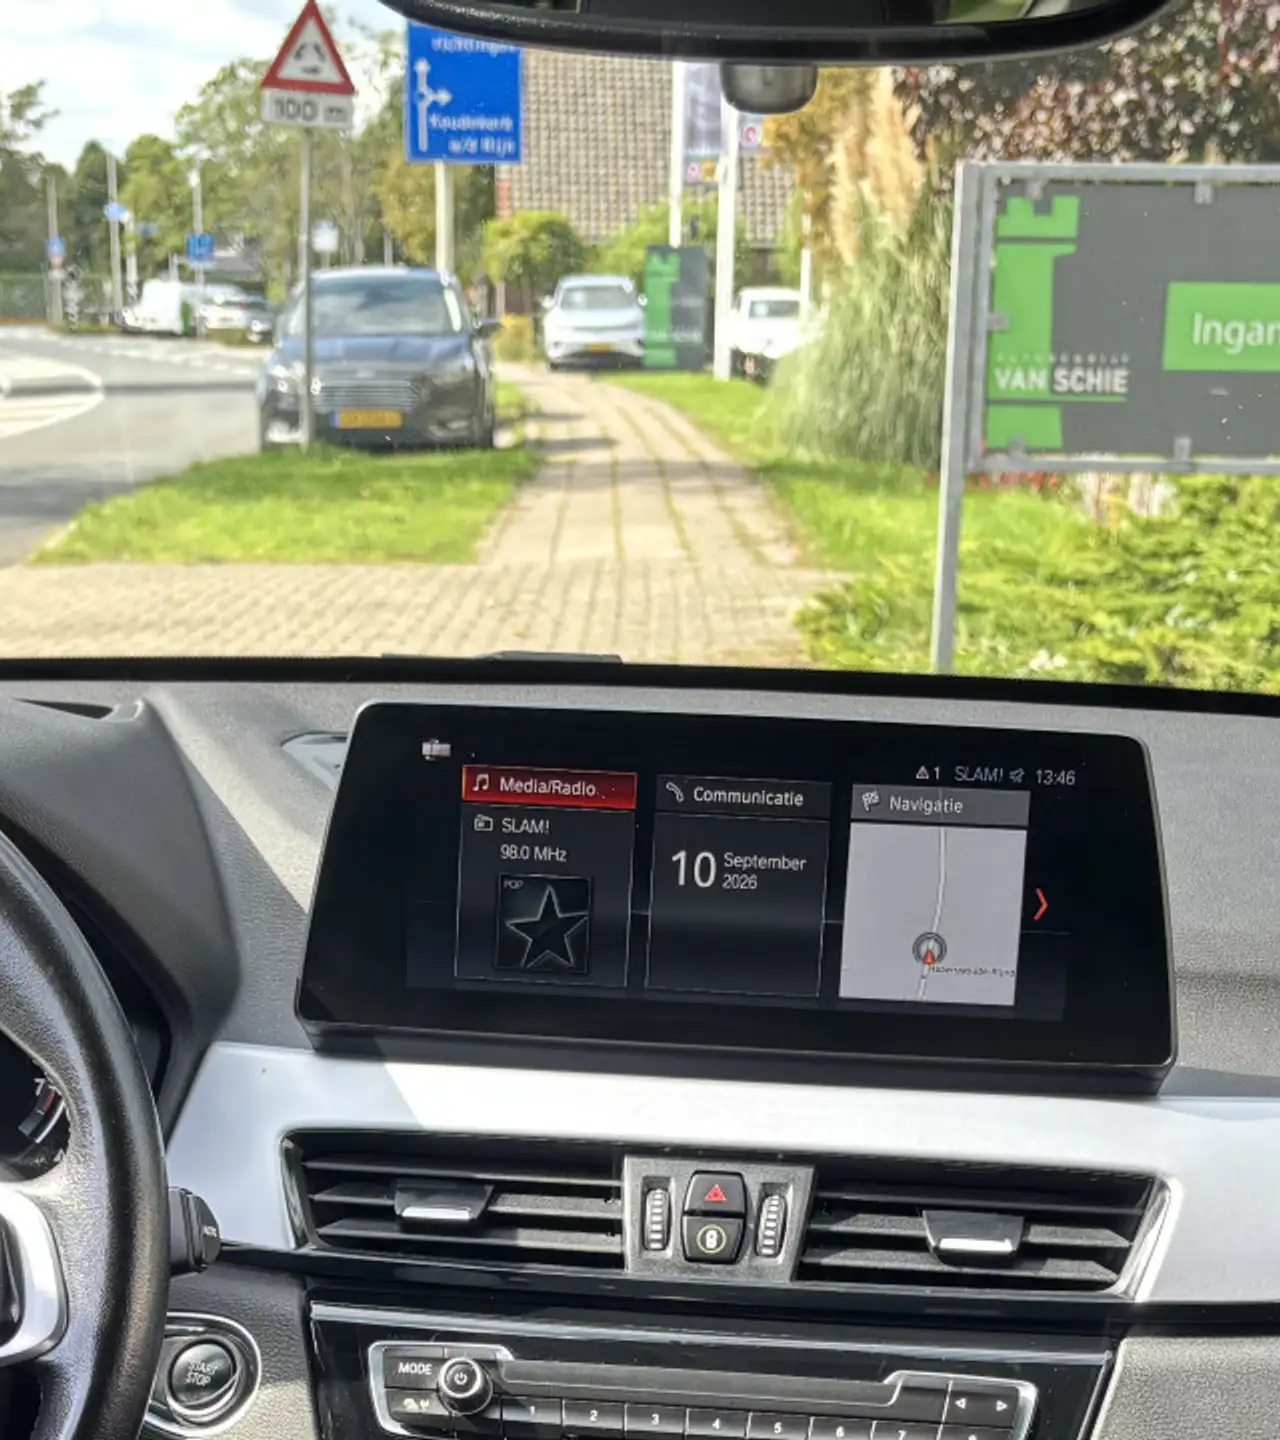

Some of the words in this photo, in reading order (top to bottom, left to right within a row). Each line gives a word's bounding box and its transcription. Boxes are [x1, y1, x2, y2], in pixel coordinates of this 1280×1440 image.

[274, 98, 318, 121] 100
[324, 106, 346, 122] m
[994, 368, 1048, 391] VAN
[1053, 366, 1130, 393] SCHIE
[954, 766, 1003, 783] SLAM!
[1036, 769, 1076, 786] 13:46
[500, 776, 596, 797] Media/Radio
[693, 786, 804, 807] Communicatie
[890, 796, 964, 815] Navigatie
[501, 818, 550, 834] SLAM!
[500, 844, 530, 860] 98.0
[534, 846, 567, 862] MHz
[723, 852, 807, 871] September
[672, 850, 717, 888] 10
[503, 880, 524, 890] POP
[722, 874, 758, 889] 2026
[33, 1077, 46, 1096] 7
[398, 1361, 433, 1375] MODE
[186, 1373, 212, 1387] STOP
[589, 1409, 599, 1422] 2
[651, 1413, 660, 1426] 3
[711, 1417, 721, 1430] 4
[773, 1422, 783, 1434] 5
[835, 1426, 845, 1438] 6
